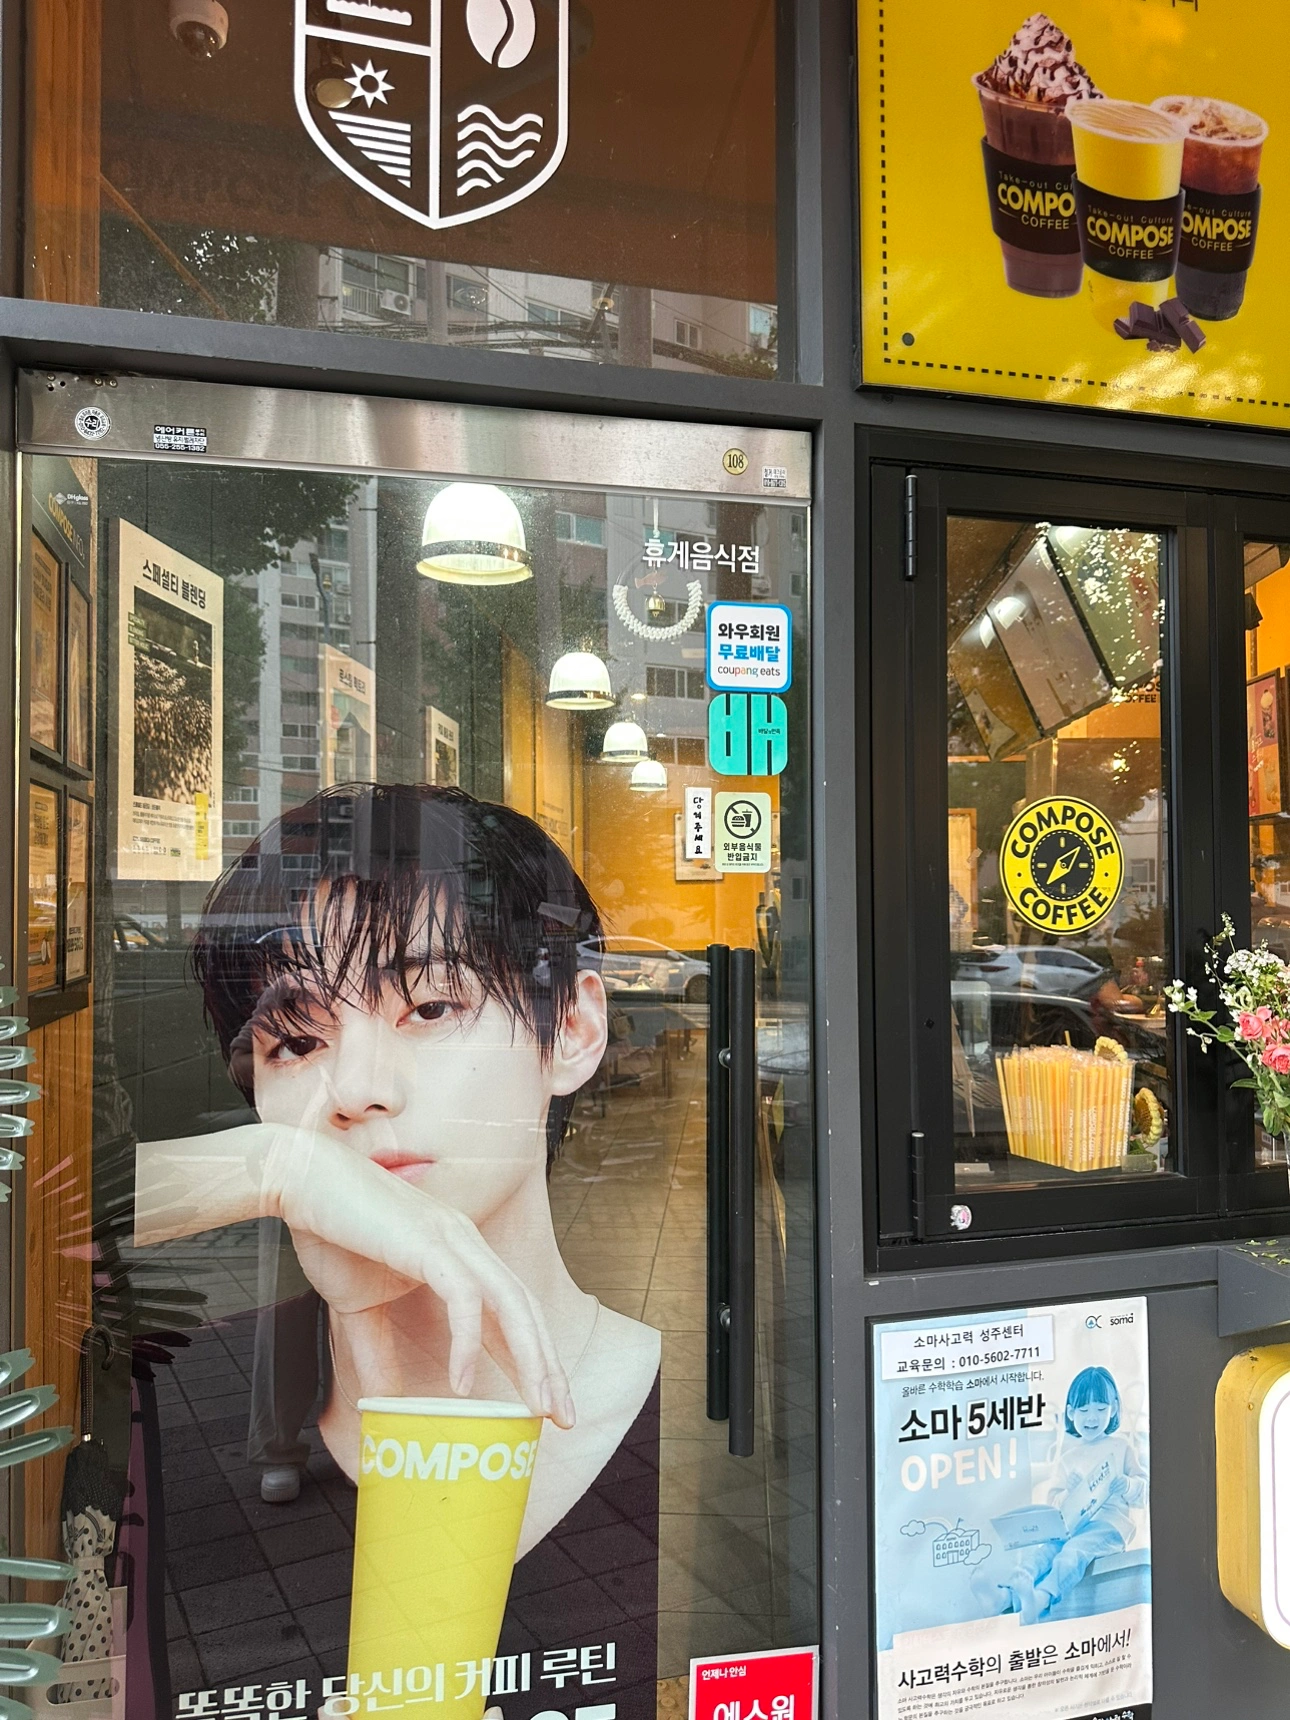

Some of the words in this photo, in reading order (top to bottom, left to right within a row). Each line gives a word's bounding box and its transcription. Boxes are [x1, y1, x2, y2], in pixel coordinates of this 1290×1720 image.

[997, 183, 1076, 217] COMPO
[1021, 214, 1069, 229] COFFEE
[1086, 215, 1174, 248] COMPOSE
[1181, 211, 1252, 241] OMPOSE
[1108, 244, 1154, 259] COFFEE
[1191, 236, 1233, 252] COFFEE
[728, 454, 744, 468] 108
[642, 539, 760, 574] 휴게음식점
[141, 558, 180, 597] 스페셜티
[181, 577, 207, 609] 블렌딩
[717, 622, 780, 642] 와우회원
[718, 644, 780, 662] 무료배달
[717, 665, 758, 677] coupang
[760, 667, 780, 676] eats
[1011, 805, 1115, 860] COMPOSE
[723, 842, 762, 852] 외부음식물
[727, 852, 758, 862] 반입금지
[1019, 886, 1109, 925] COFFEE
[1110, 1312, 1134, 1327] soma
[913, 1331, 973, 1349] 소마사고력
[979, 1323, 1024, 1342] 성주센터
[896, 1357, 945, 1373] 교육문의
[958, 1346, 1040, 1368] 010-5602-7711
[901, 1383, 926, 1398] 올바른
[928, 1379, 964, 1394] 수학학습
[966, 1375, 998, 1390] 소마에서
[1000, 1370, 1045, 1384] 시작합니다.
[898, 1404, 962, 1443] 소마
[967, 1393, 1046, 1436] 5세반
[897, 1653, 1002, 1690] 사고력수학의
[1008, 1644, 1059, 1672] 출발은
[1063, 1628, 1132, 1661] 소마에서!
[322, 1662, 446, 1717] 당신의
[454, 1652, 532, 1700] 커피
[540, 1642, 617, 1689] 루틴
[701, 1667, 729, 1681] 언제나
[729, 1665, 747, 1677] 안심
